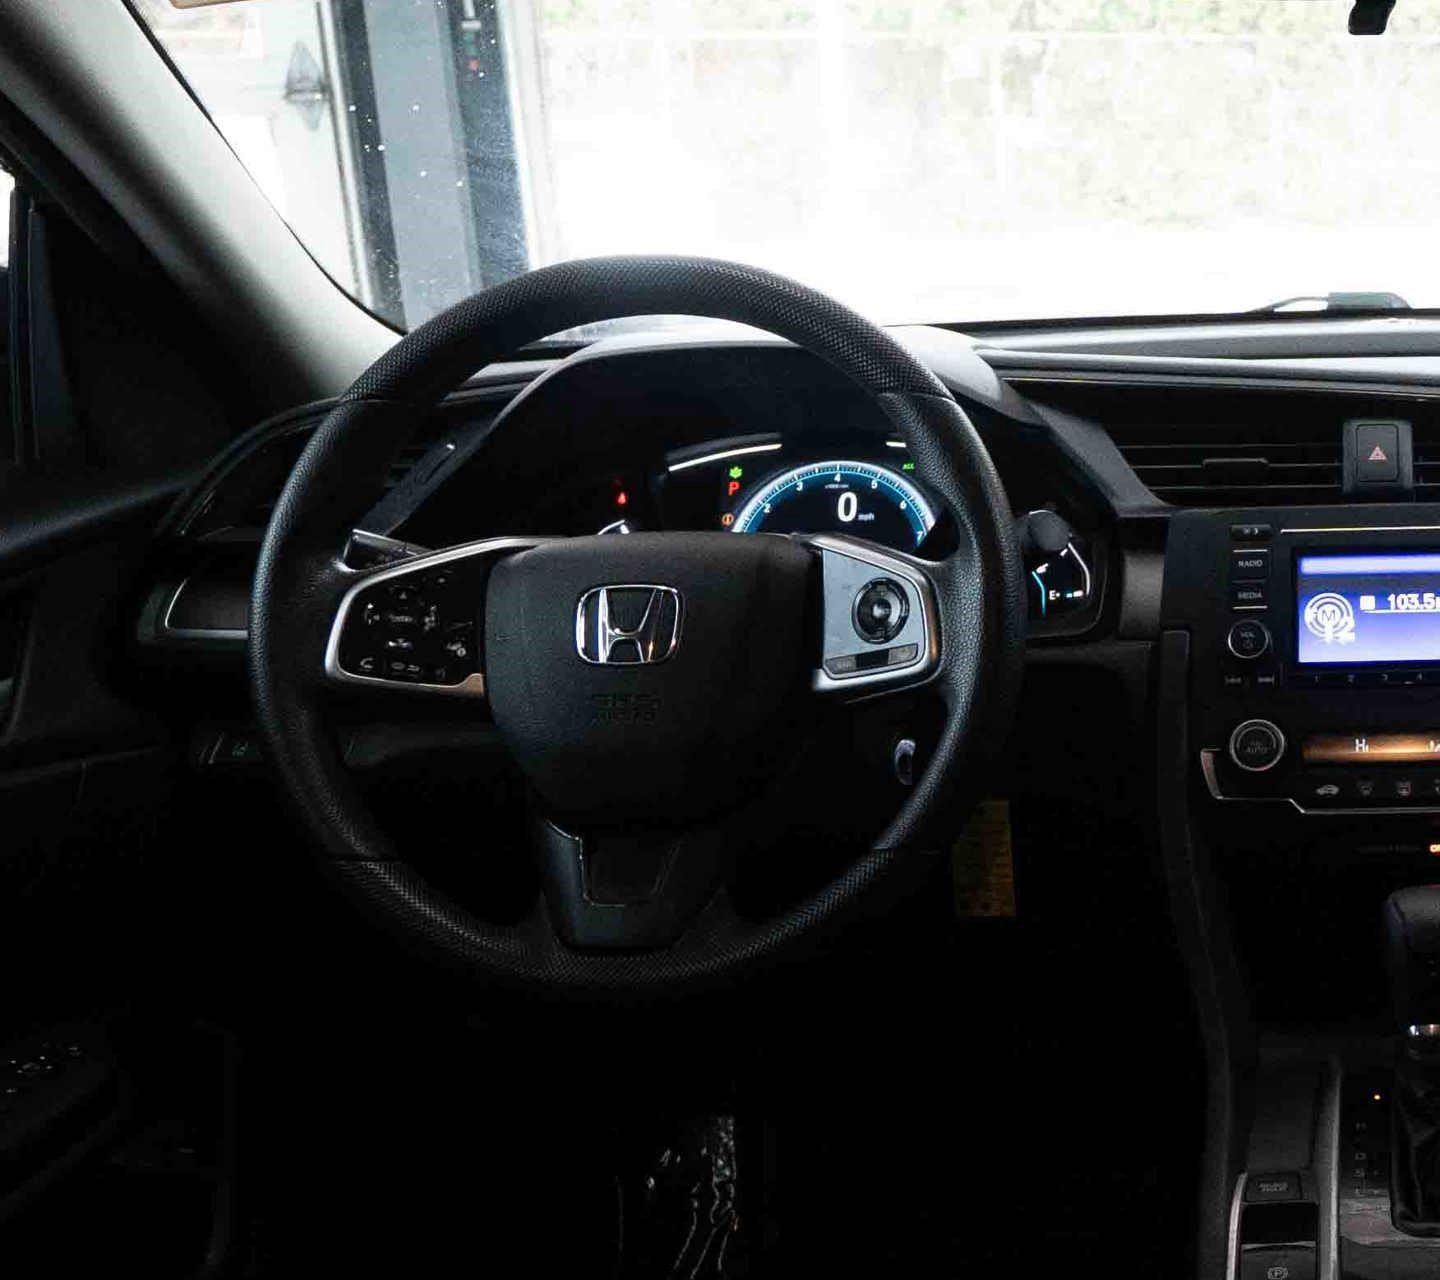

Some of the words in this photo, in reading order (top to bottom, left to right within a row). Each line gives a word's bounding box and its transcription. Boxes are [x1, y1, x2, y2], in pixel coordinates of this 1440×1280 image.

[833, 473, 842, 483] 4
[728, 480, 741, 496] P
[795, 482, 804, 492] 3
[871, 480, 879, 490] 5
[837, 491, 859, 523] 0
[899, 500, 907, 510] 6
[1237, 559, 1264, 568] RADIO
[1237, 591, 1264, 600] MEDIA
[1387, 593, 1435, 611] 103.5
